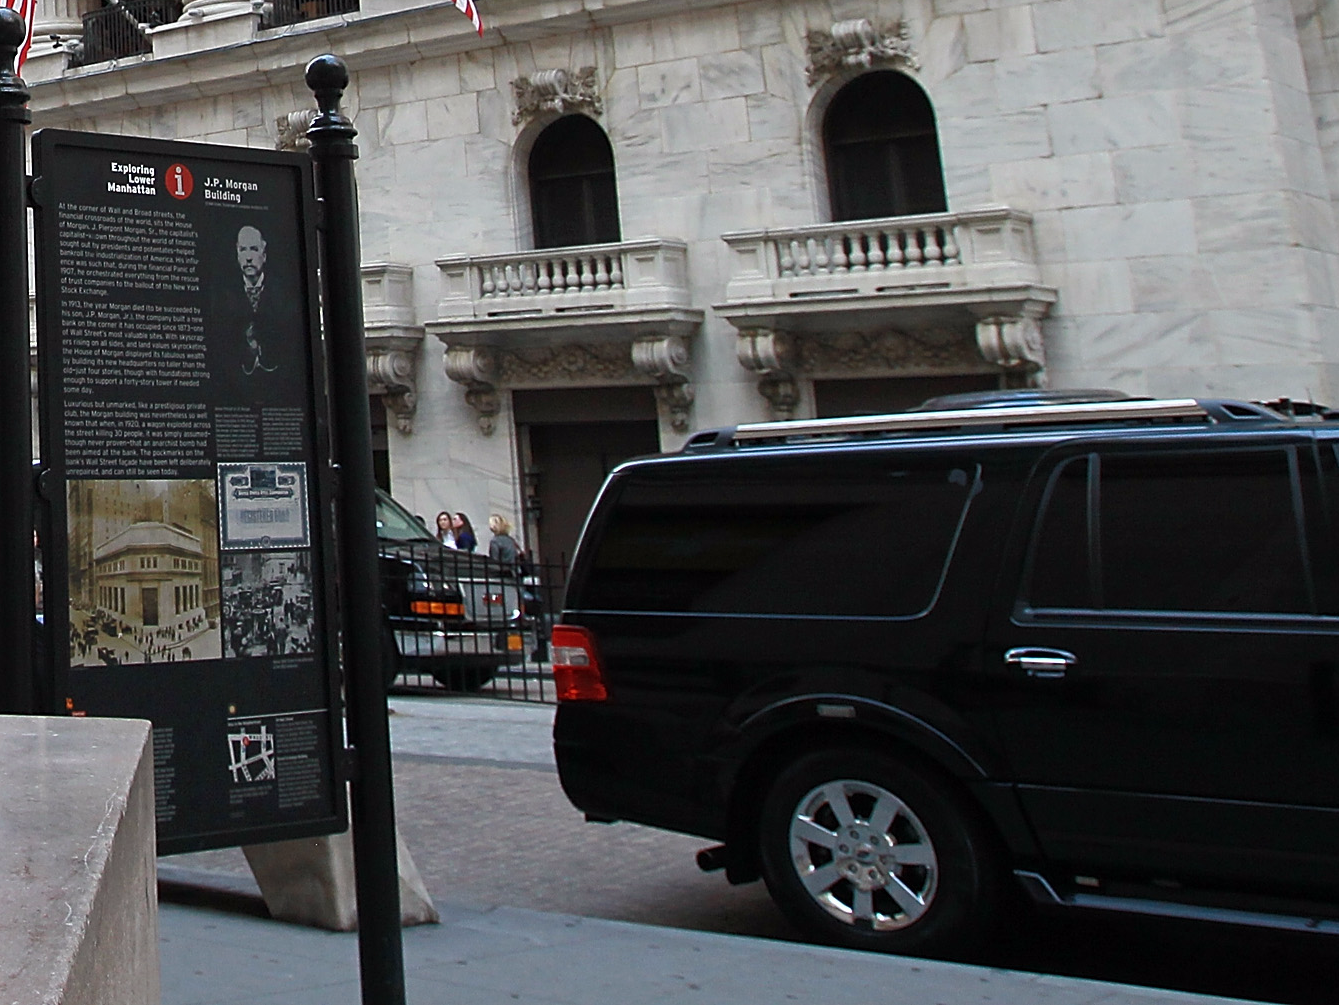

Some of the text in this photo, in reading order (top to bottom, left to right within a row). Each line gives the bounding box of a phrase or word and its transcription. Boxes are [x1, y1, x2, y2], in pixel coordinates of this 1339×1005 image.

[111, 162, 155, 176] Exploring
[128, 174, 155, 185] Lower
[108, 182, 156, 195] Manhattan
[204, 178, 258, 192] J.P. Morgan
[205, 190, 241, 203] Building
[99, 224, 122, 233] Pierpont
[169, 230, 198, 238] capitalist's
[109, 234, 139, 243] throughout
[101, 243, 130, 251] presidents
[118, 262, 136, 271] during
[125, 272, 154, 281] everything
[84, 279, 115, 287] companies
[109, 303, 131, 311] Morgan
[147, 315, 171, 323] company
[84, 329, 107, 337] Street's
[73, 339, 90, 347] rising
[102, 349, 124, 358] Morgan
[72, 358, 95, 366] building
[124, 369, 144, 377] though
[64, 377, 85, 385] enough
[95, 378, 117, 386] support
[124, 378, 154, 387] forty-story
[155, 402, 185, 411] prestigious
[91, 410, 113, 419] Morgan
[115, 411, 138, 419] building
[167, 421, 192, 429] exploded
[96, 430, 113, 438] killing
[164, 430, 182, 439] simply
[65, 439, 86, 447] though
[153, 449, 184, 457] pockmarks
[119, 458, 137, 466] façade
[180, 459, 211, 467] deliberately
